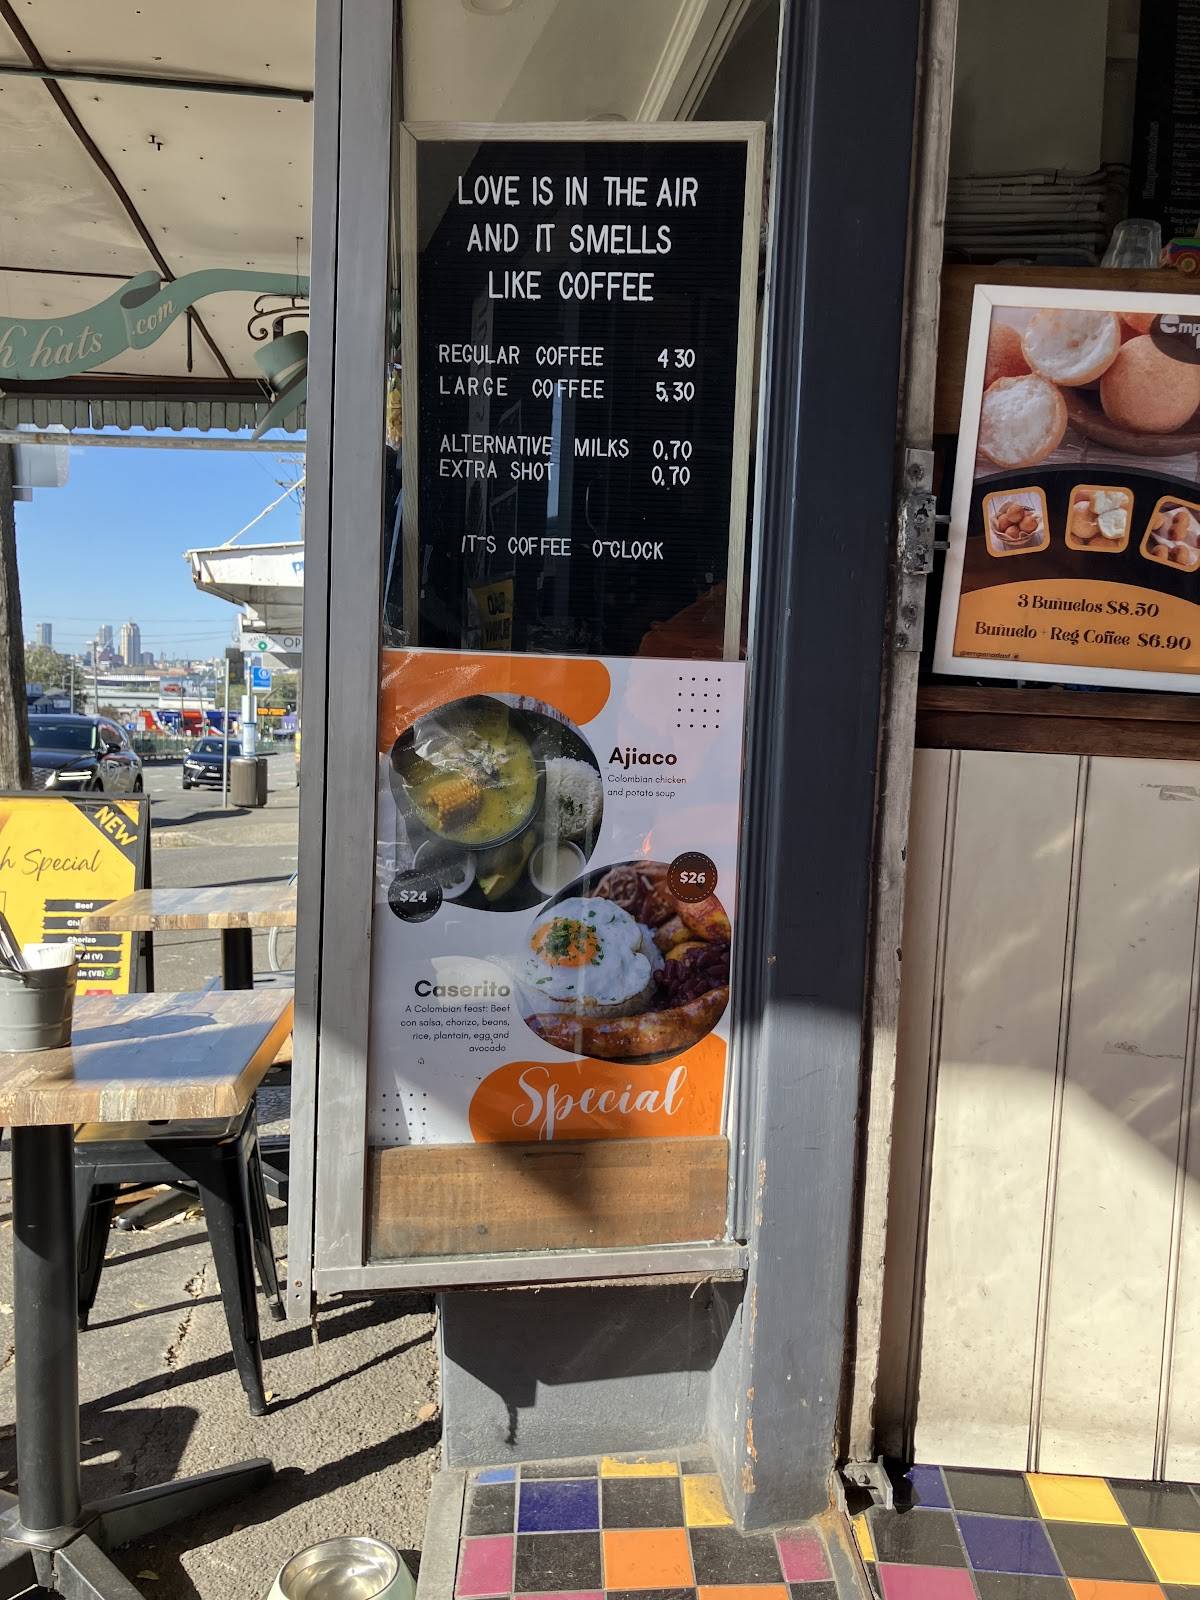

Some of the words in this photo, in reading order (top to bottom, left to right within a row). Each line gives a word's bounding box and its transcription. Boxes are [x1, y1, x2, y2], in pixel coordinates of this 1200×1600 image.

[458, 175, 520, 206] LOVE
[532, 176, 554, 206] IS
[565, 176, 588, 206] IN
[604, 176, 648, 207] THE
[656, 177, 699, 208] AIR
[467, 223, 519, 252] AND
[536, 223, 555, 252] IT
[569, 224, 672, 254] SMELLS
[488, 270, 542, 300] LIKE
[558, 271, 655, 301] COFFEE
[29, 325, 104, 368] hats
[131, 300, 178, 336] .com
[438, 343, 520, 366] REGULAR
[535, 346, 605, 367] COFFEE
[439, 375, 509, 397] LARGE
[531, 378, 605, 399] COFFEE
[439, 434, 554, 457] ALTERNATIVE
[574, 437, 630, 459] MILKS
[652, 439, 693, 462] 0.70
[438, 459, 498, 479] EXTRA
[510, 461, 555, 482] SHOT
[507, 536, 572, 556] COFFEE
[1017, 593, 1029, 608] 3
[1031, 595, 1103, 614] Buñuelos
[1105, 599, 1160, 618] $8.50
[974, 620, 1038, 639] Buñuelo
[1050, 626, 1080, 646] Reg
[1083, 629, 1131, 646] Coffee
[1136, 632, 1192, 651] $6.90
[608, 746, 678, 770] Ajiaco
[607, 774, 653, 784] Colombian
[655, 775, 687, 785] chicken
[607, 787, 624, 797] and
[625, 788, 653, 799] potato
[655, 790, 676, 799] soup
[94, 805, 138, 846] NEW
[22, 848, 101, 882] Special
[679, 870, 706, 884] $26
[399, 889, 428, 903] $24
[414, 979, 511, 998] Caserito
[404, 1005, 412, 1013] A
[414, 1004, 461, 1013] Colombian
[463, 1004, 489, 1013] feast:
[490, 1004, 511, 1013] Beef
[419, 1018, 444, 1028] salsa,
[446, 1017, 479, 1028] chorizo,
[481, 1018, 510, 1027] beans,
[412, 1032, 431, 1041] rice,
[433, 1031, 471, 1042] plantain,
[473, 1034, 491, 1042] egg
[493, 1031, 510, 1039] and
[468, 1043, 507, 1052] avocado
[511, 1065, 688, 1141] Special
